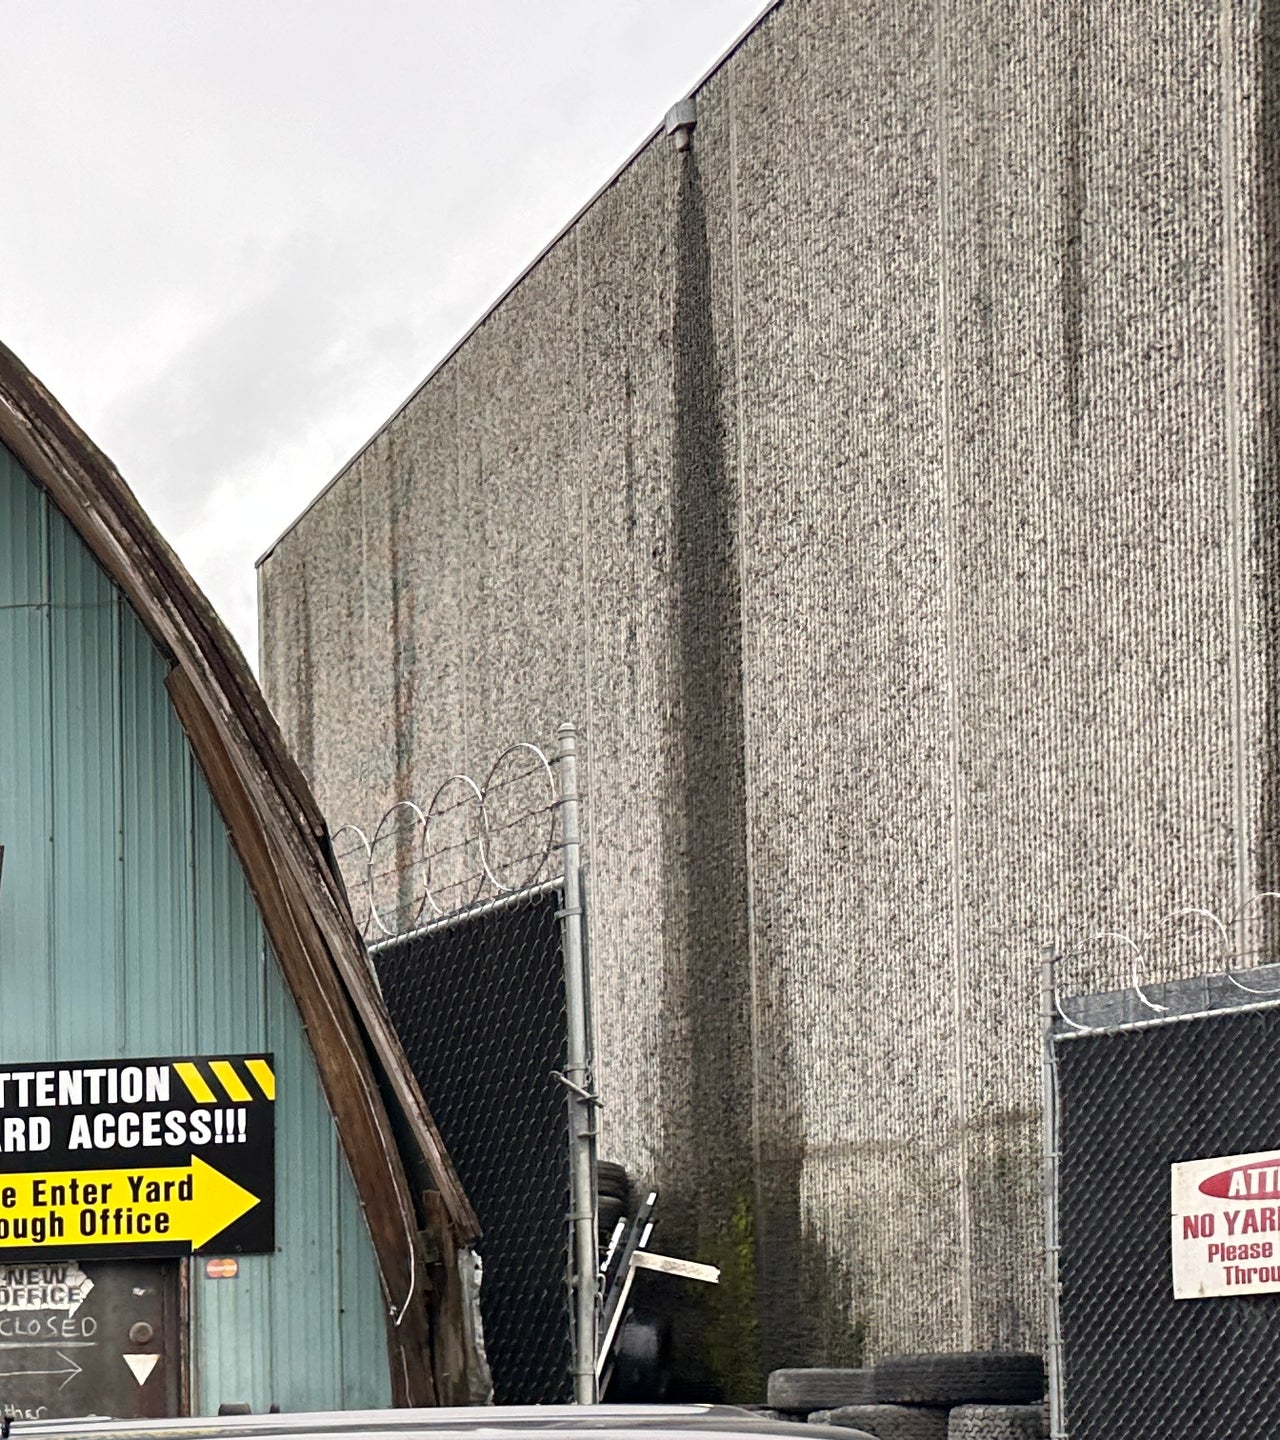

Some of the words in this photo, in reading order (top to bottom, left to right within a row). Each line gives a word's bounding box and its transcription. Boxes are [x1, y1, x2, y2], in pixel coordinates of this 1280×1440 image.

[68, 1108, 247, 1150] ACCESS!!!
[33, 1178, 113, 1207] Enter
[127, 1174, 194, 1203] Yard
[1228, 1165, 1280, 1197] ATT
[80, 1206, 170, 1237] Office
[1183, 1213, 1215, 1240] NO
[1223, 1206, 1280, 1236] YAR
[1208, 1242, 1273, 1263] Please
[5, 1267, 67, 1285] NEW
